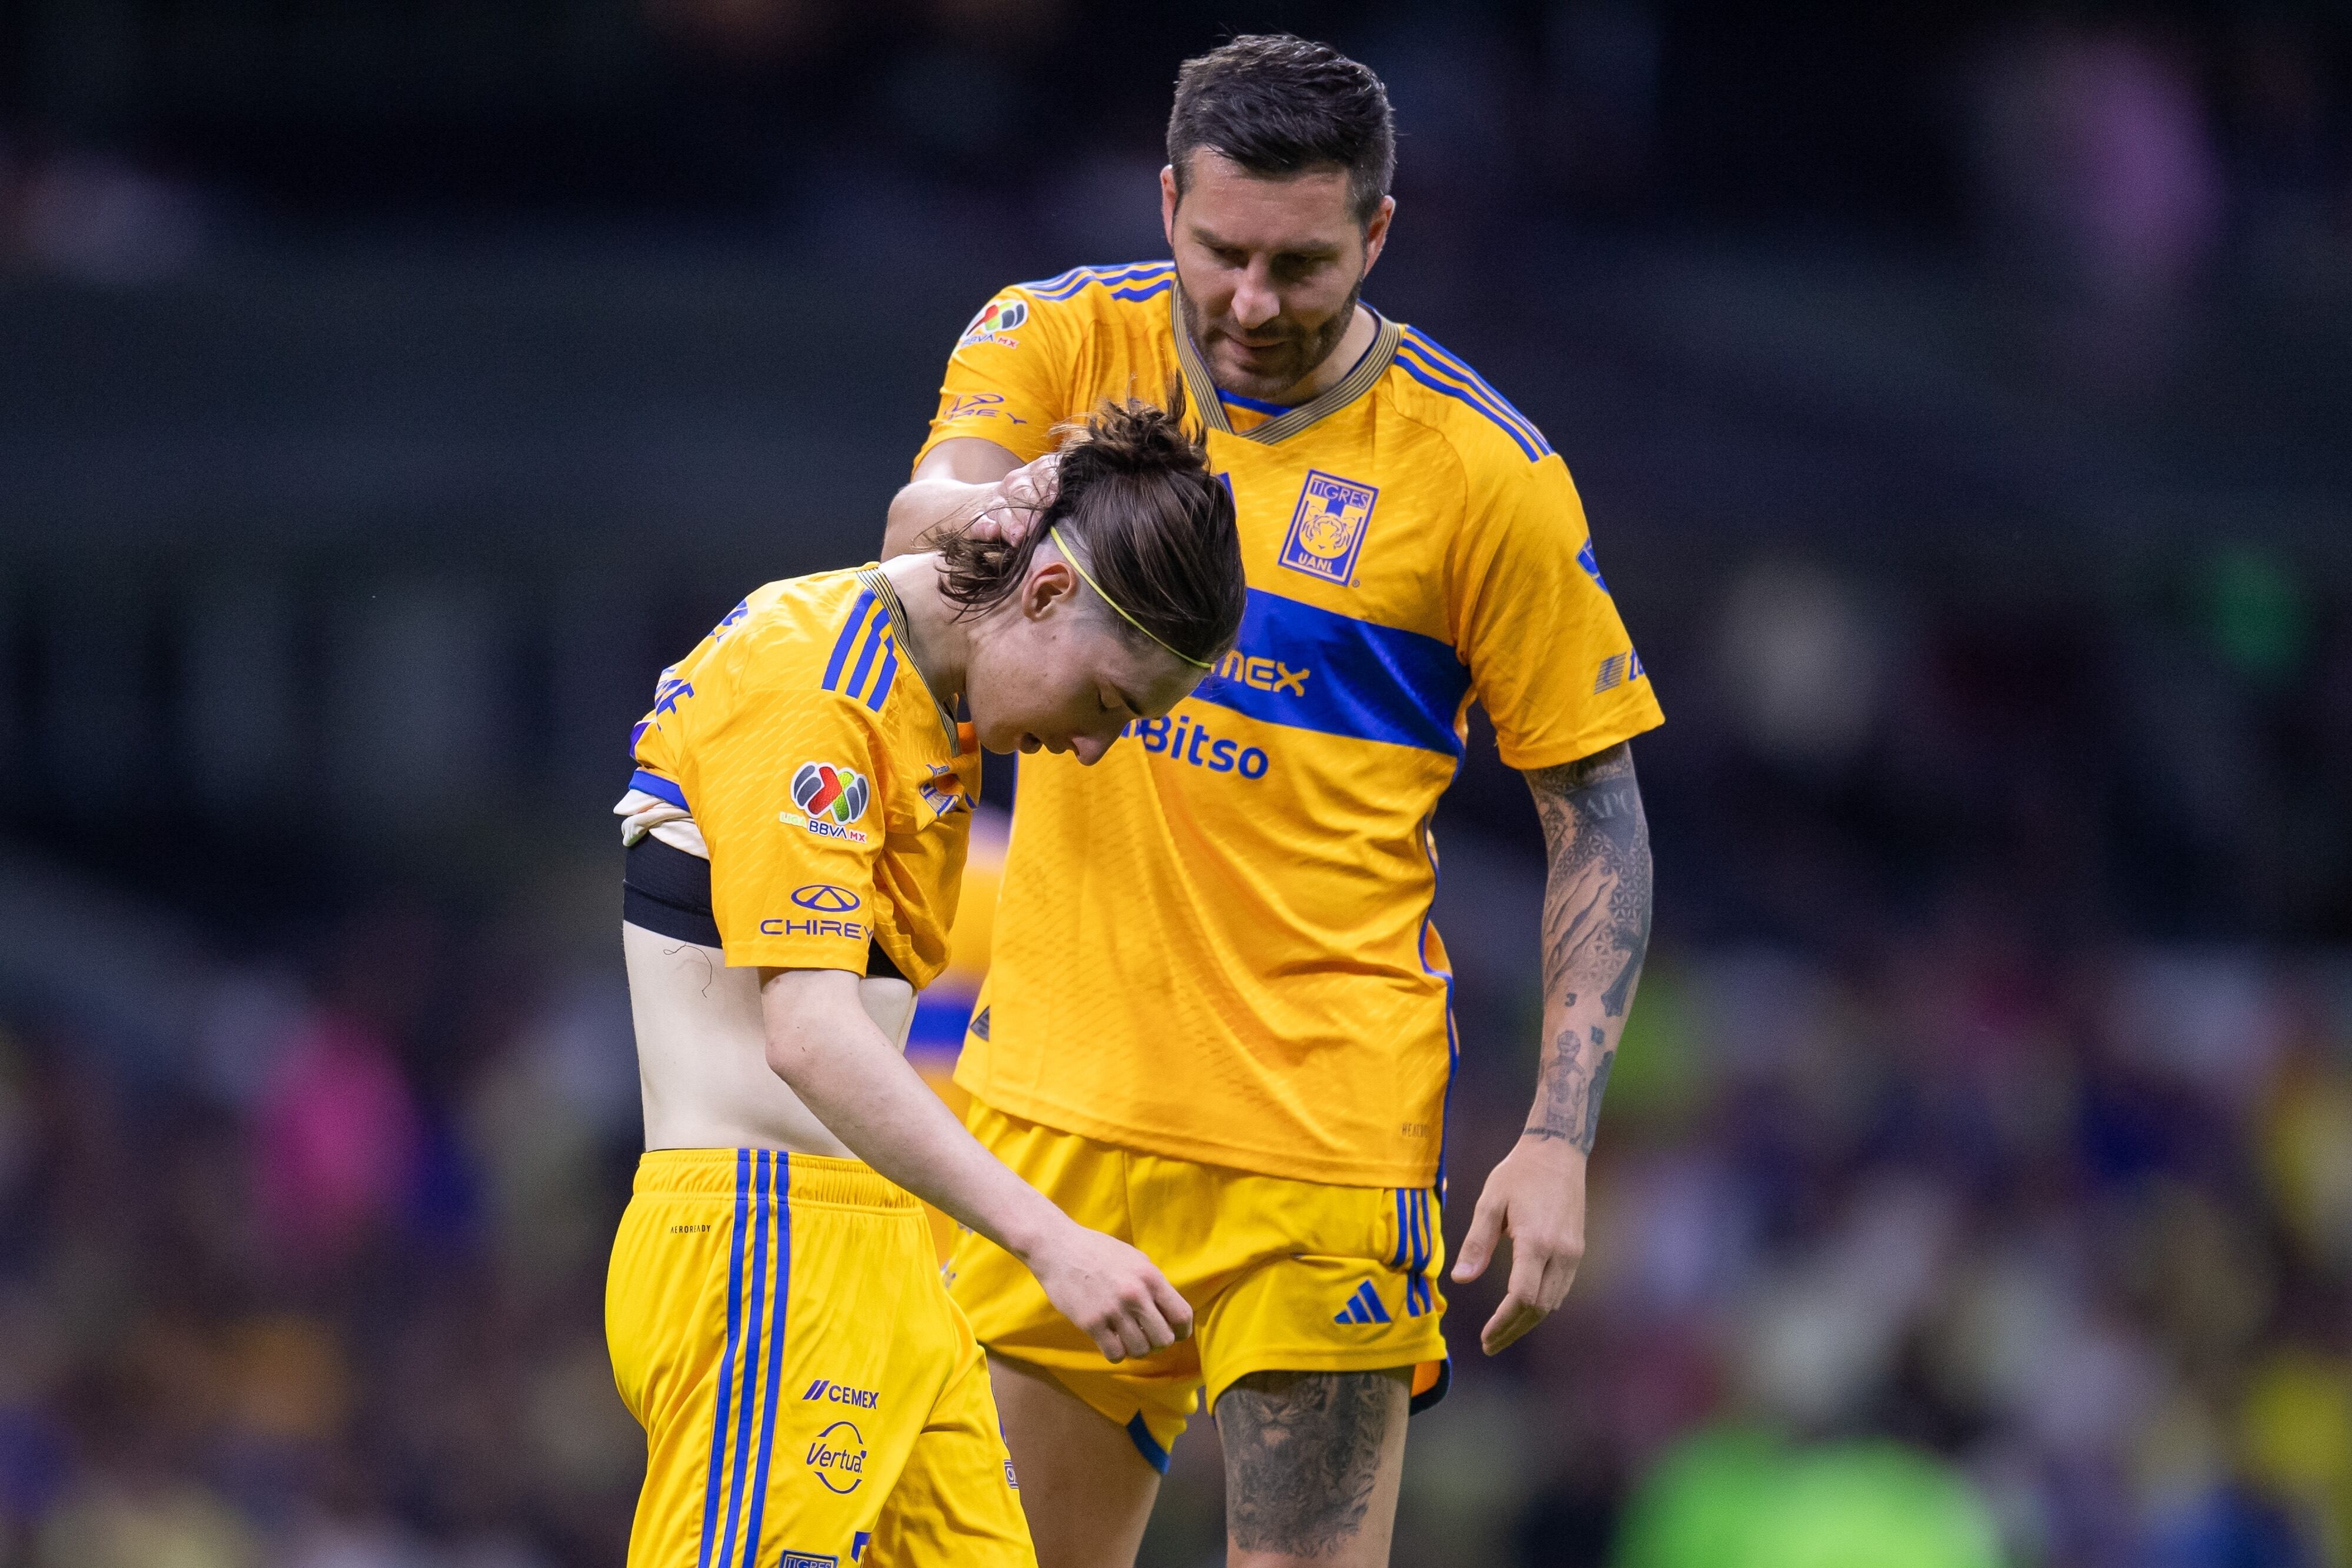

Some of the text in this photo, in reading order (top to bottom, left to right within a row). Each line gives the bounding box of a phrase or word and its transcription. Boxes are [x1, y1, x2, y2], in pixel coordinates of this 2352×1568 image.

[998, 337, 1017, 348] MX
[1312, 479, 1369, 510] TIGRES
[1298, 552, 1332, 573] UANL
[1142, 714, 1268, 780] Bitso
[781, 813, 866, 842] LIGA BBVA MX
[760, 919, 874, 943] CHIREY
[670, 1225, 710, 1233] AEROREADY
[828, 1385, 879, 1410] CEMEX
